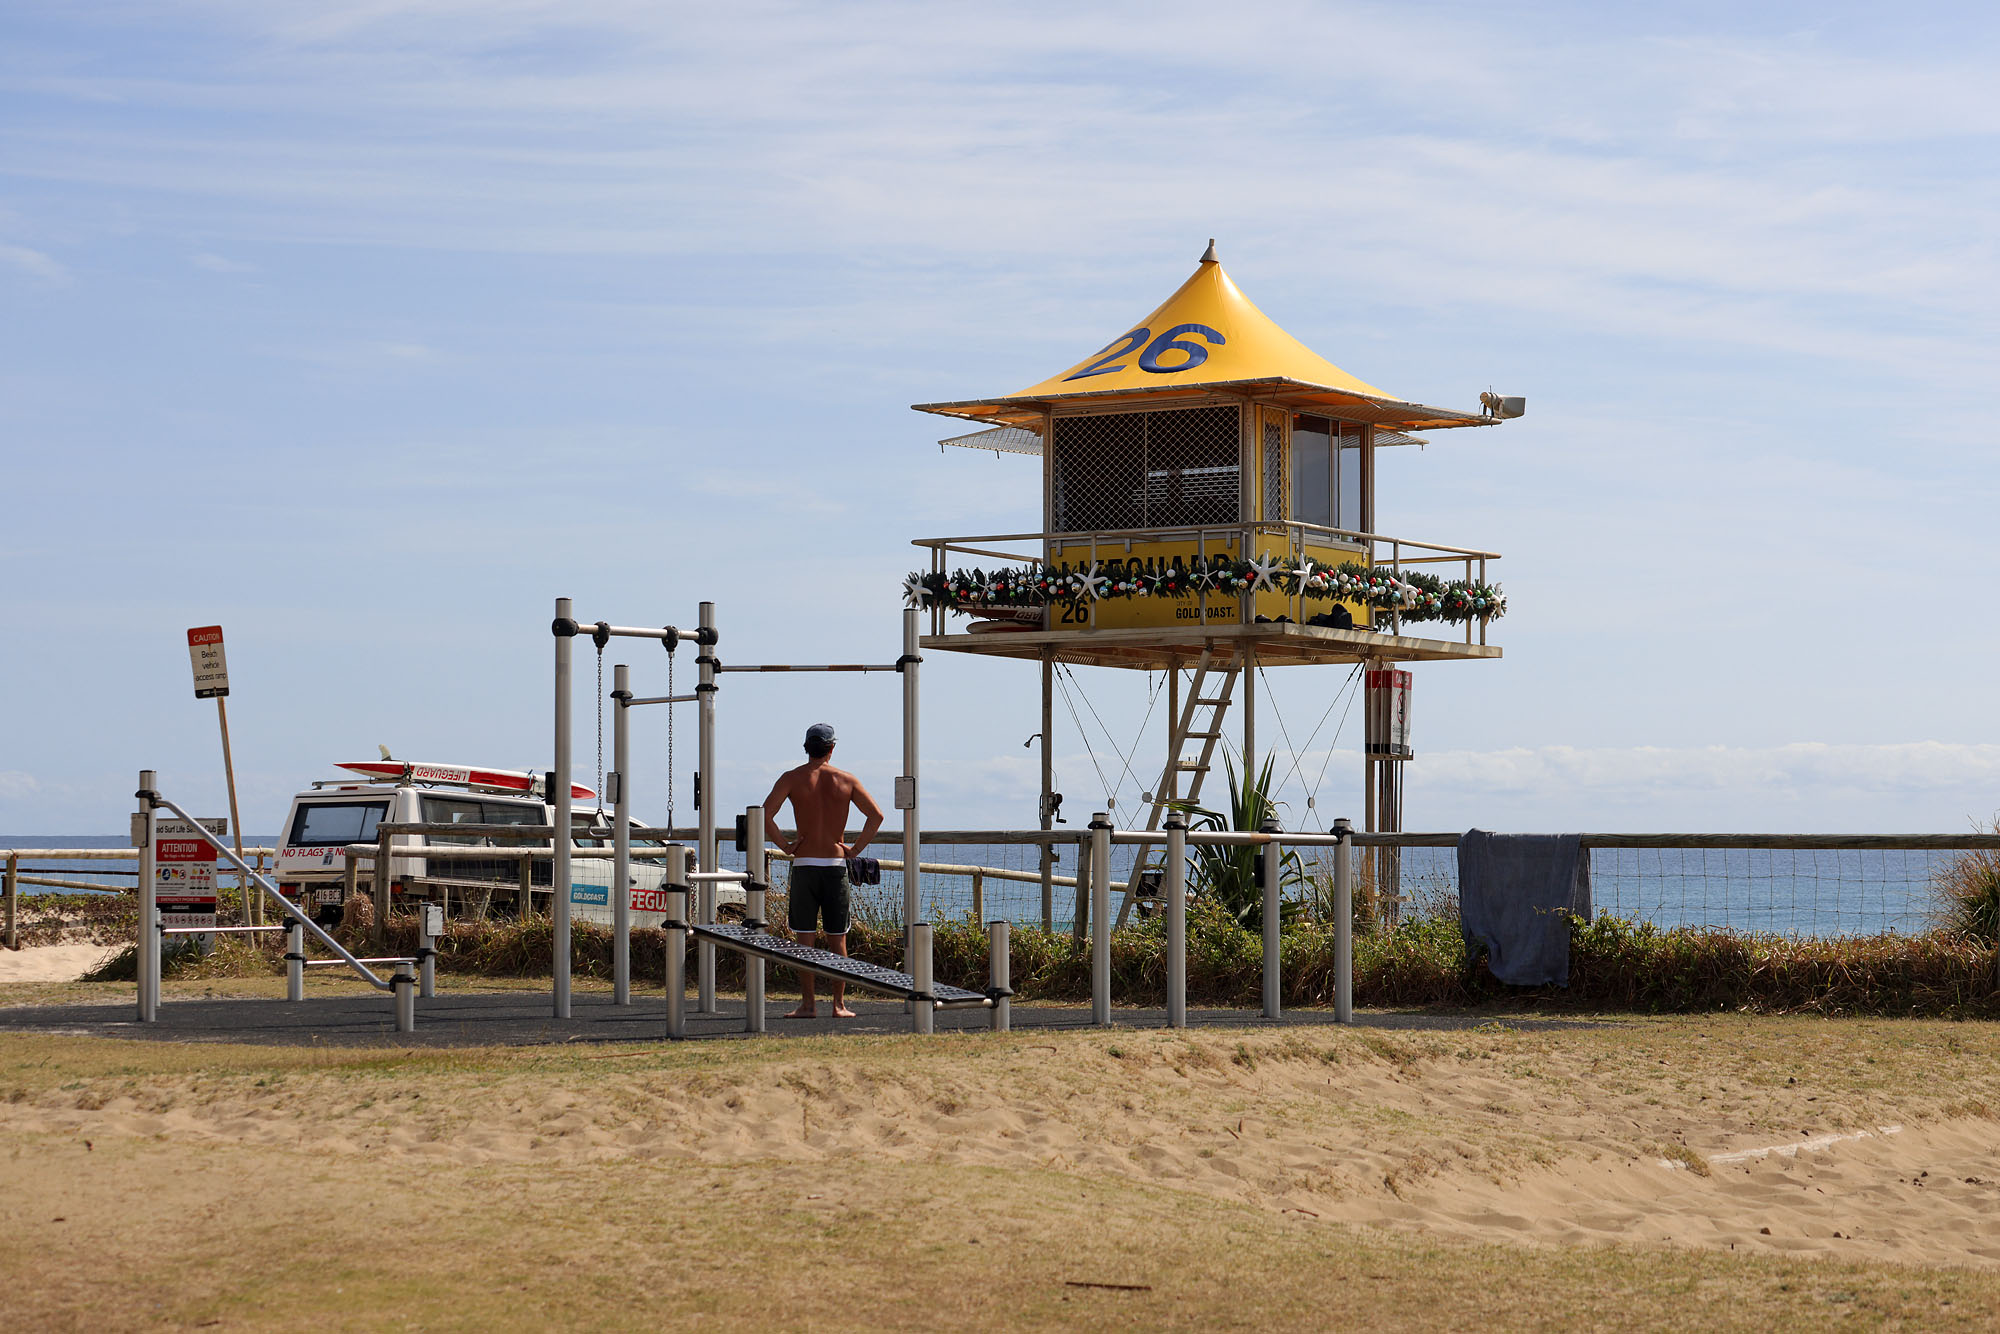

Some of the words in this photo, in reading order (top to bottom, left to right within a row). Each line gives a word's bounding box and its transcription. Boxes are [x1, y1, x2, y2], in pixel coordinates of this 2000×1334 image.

[1061, 323, 1226, 382] 26
[1061, 601, 1089, 624] 26
[1176, 606, 1235, 618] GOLDOAST.
[193, 633, 220, 642] CAUTION
[201, 649, 218, 658] Beach
[416, 766, 467, 781] LIFEGUARD
[165, 825, 176, 833] Surf
[176, 825, 185, 833] Life
[161, 843, 198, 853] ATTENTION
[281, 849, 296, 857] NO
[298, 848, 325, 857] FLAGS
[629, 890, 667, 910] FEGU
